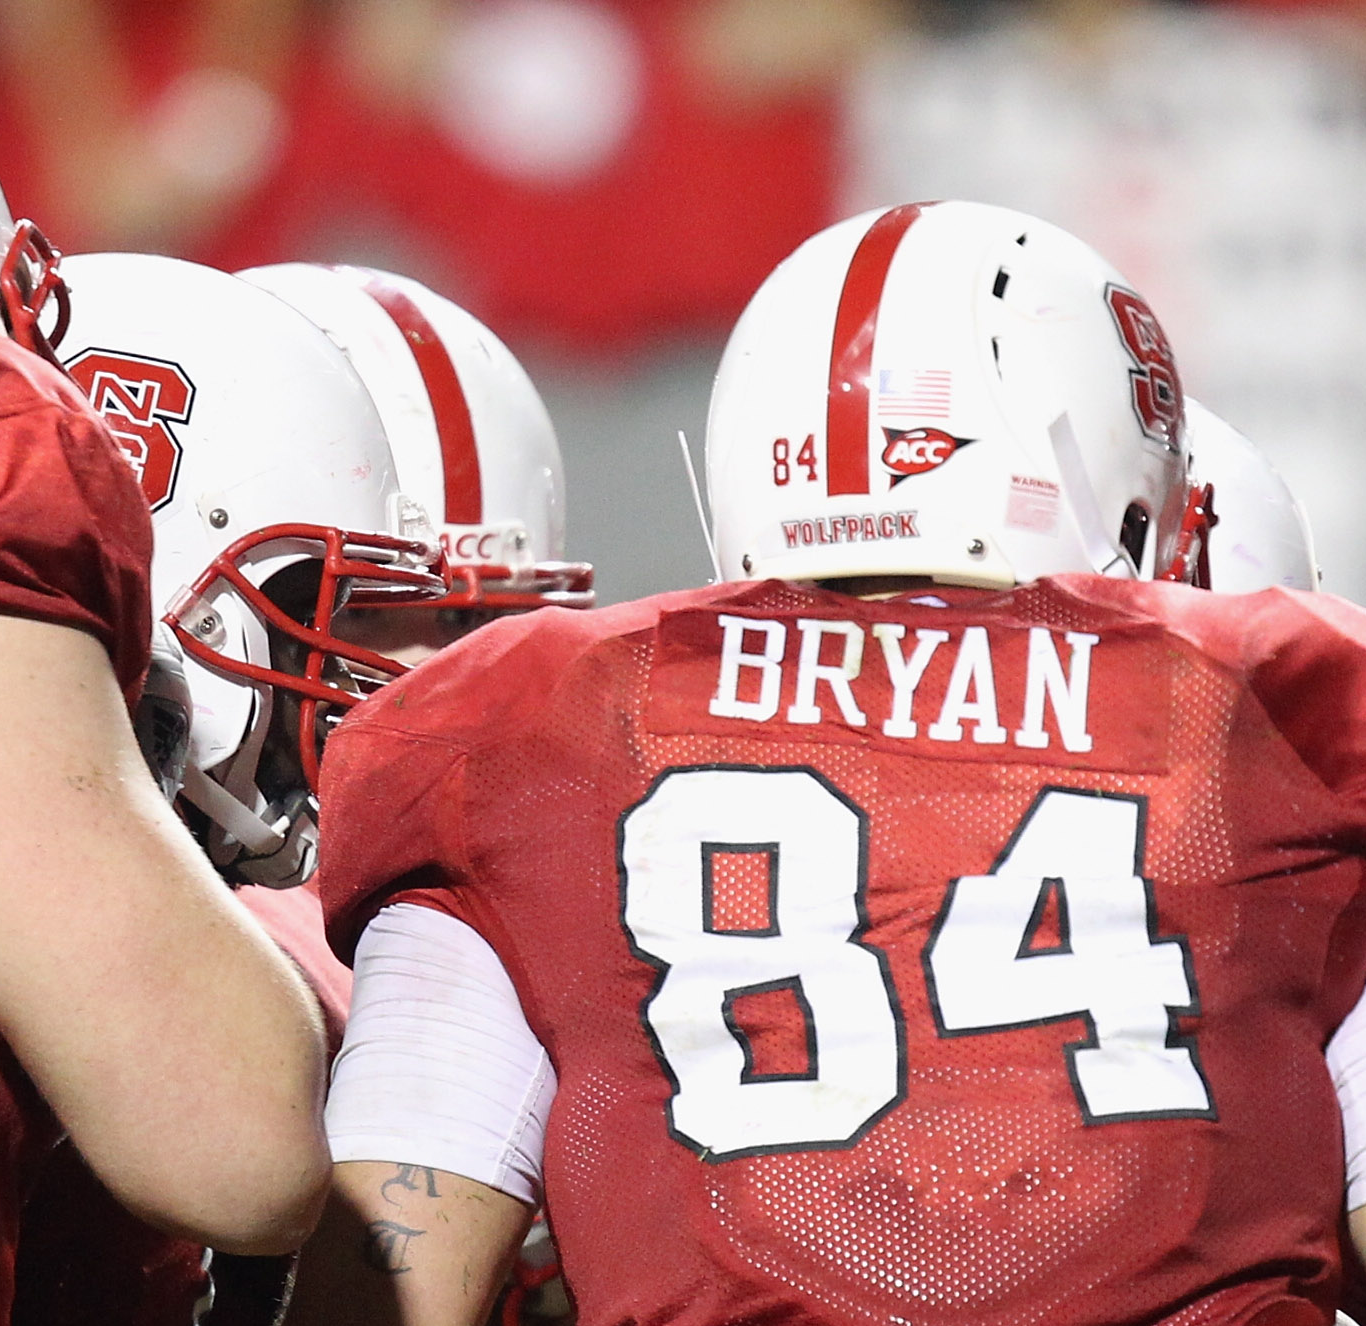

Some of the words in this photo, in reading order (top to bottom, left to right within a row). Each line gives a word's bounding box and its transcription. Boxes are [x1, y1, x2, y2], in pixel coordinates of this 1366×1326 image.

[773, 434, 818, 486] 84
[888, 440, 948, 464] ACC
[438, 532, 499, 559] ACC
[782, 510, 920, 548] WOLFPACK
[708, 612, 1099, 752] BRYAN
[617, 764, 1221, 1164] 84
